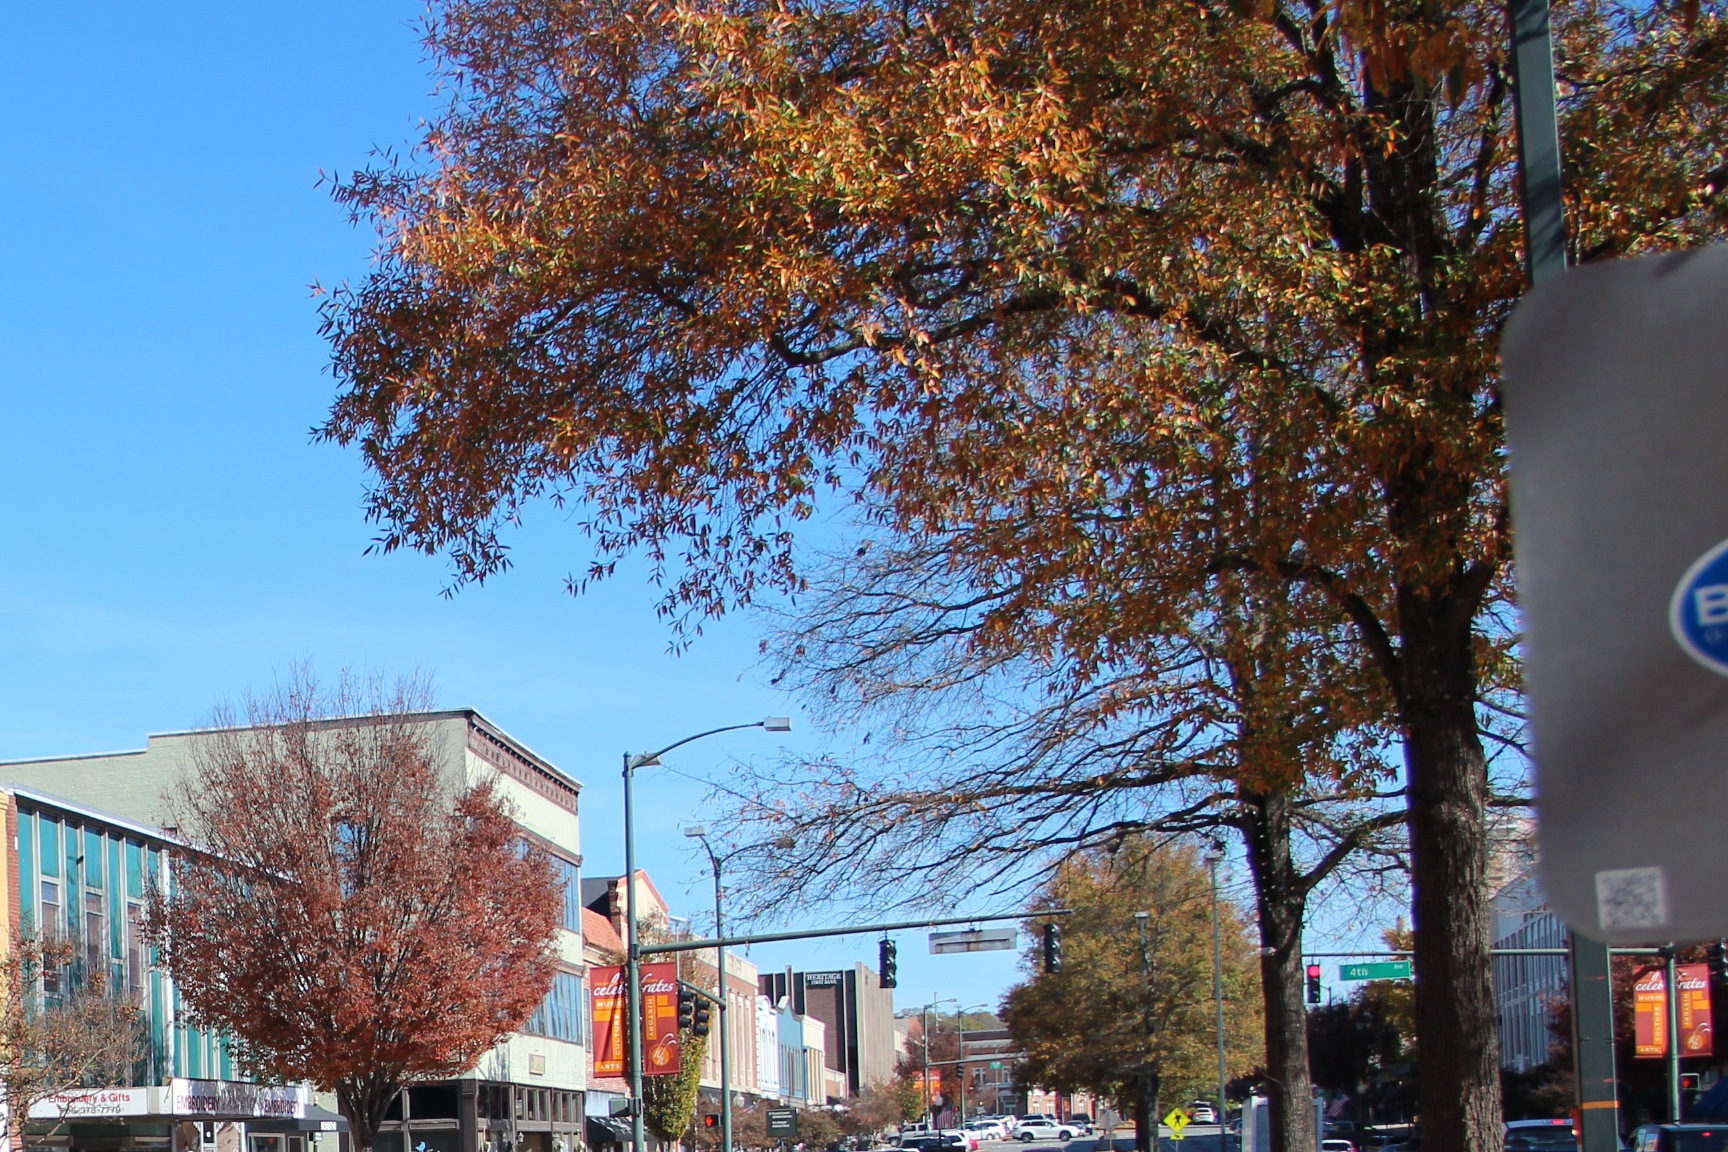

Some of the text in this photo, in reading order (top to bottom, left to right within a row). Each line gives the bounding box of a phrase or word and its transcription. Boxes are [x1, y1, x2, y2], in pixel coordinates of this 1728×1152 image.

[806, 973, 841, 981] HERITAGE
[1349, 967, 1369, 977] 4th
[597, 999, 624, 1007] MUSIC
[647, 998, 655, 1037] HISTORY
[613, 1013, 622, 1056] CULTURE
[100, 1093, 107, 1102] &
[108, 1092, 131, 1102] Gifts
[176, 1094, 221, 1111] EMBROIDERY
